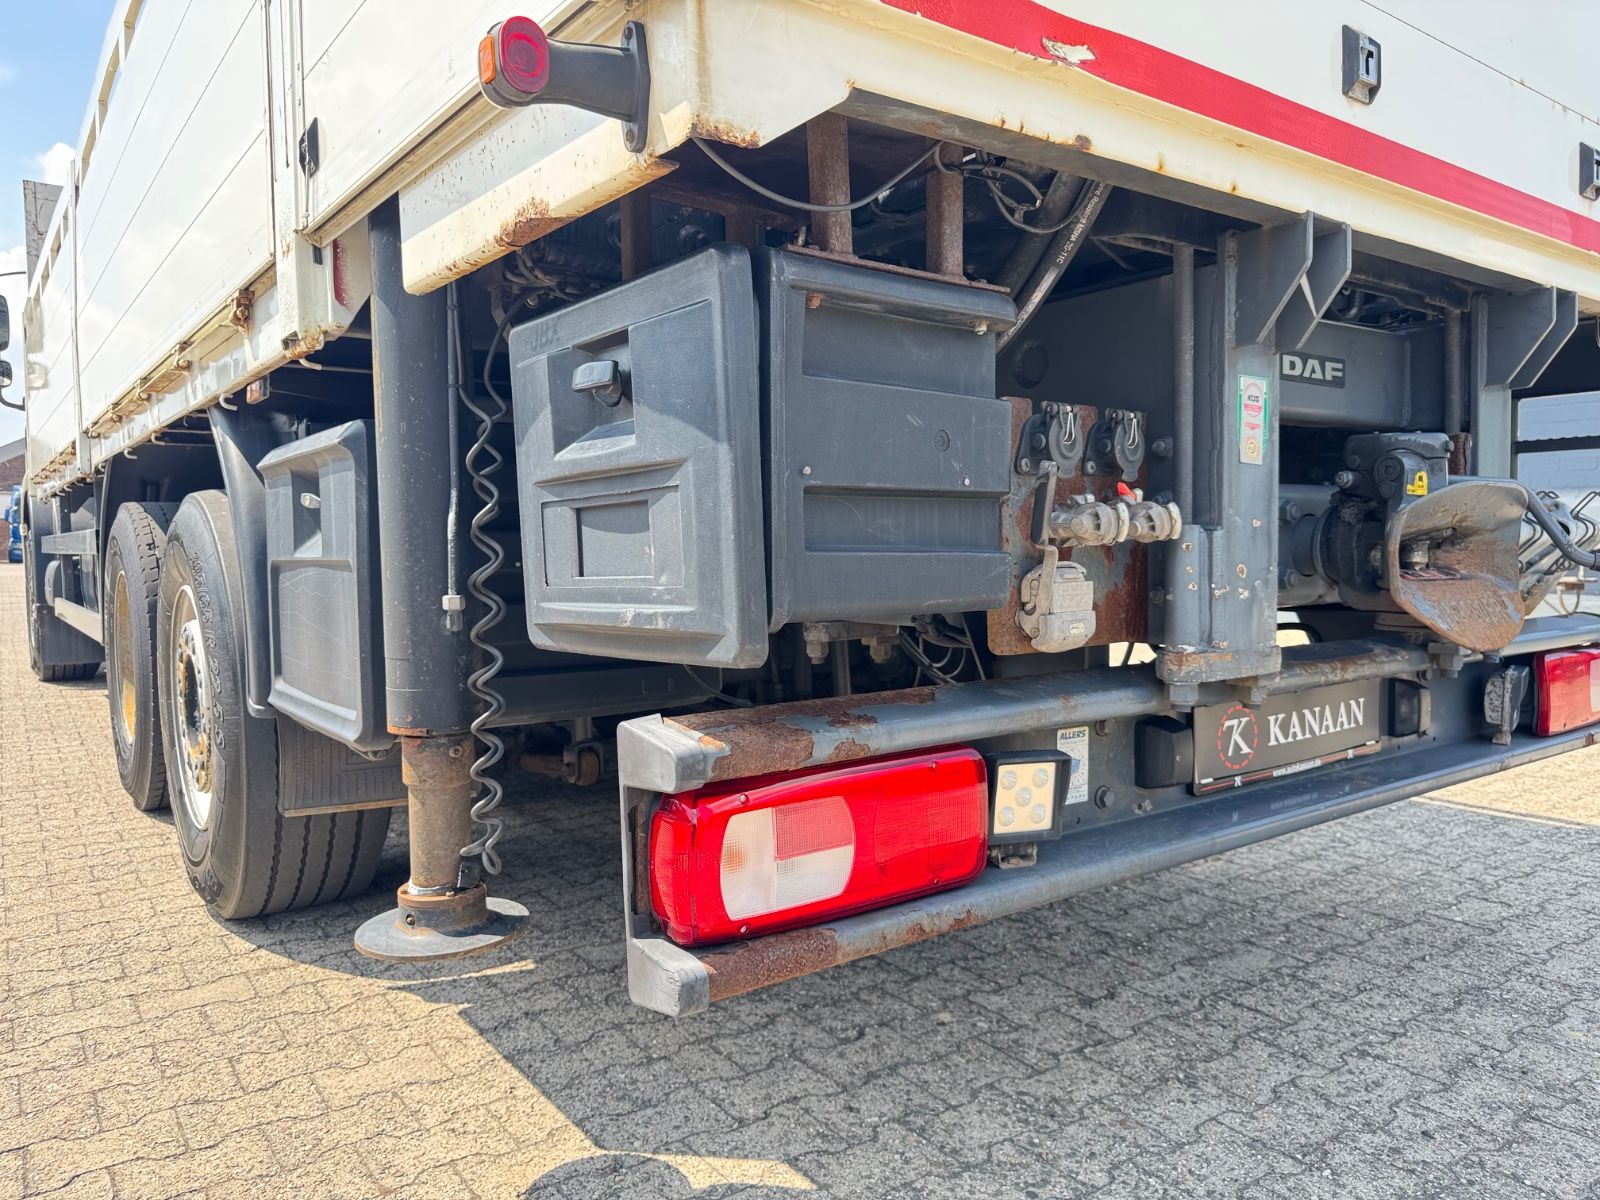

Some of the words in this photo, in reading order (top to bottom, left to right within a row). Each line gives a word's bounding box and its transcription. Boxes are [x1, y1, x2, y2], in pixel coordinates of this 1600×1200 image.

[1282, 354, 1343, 381] DAF
[1060, 730, 1087, 741] ALLERS
[1267, 698, 1365, 746] KANAAN
